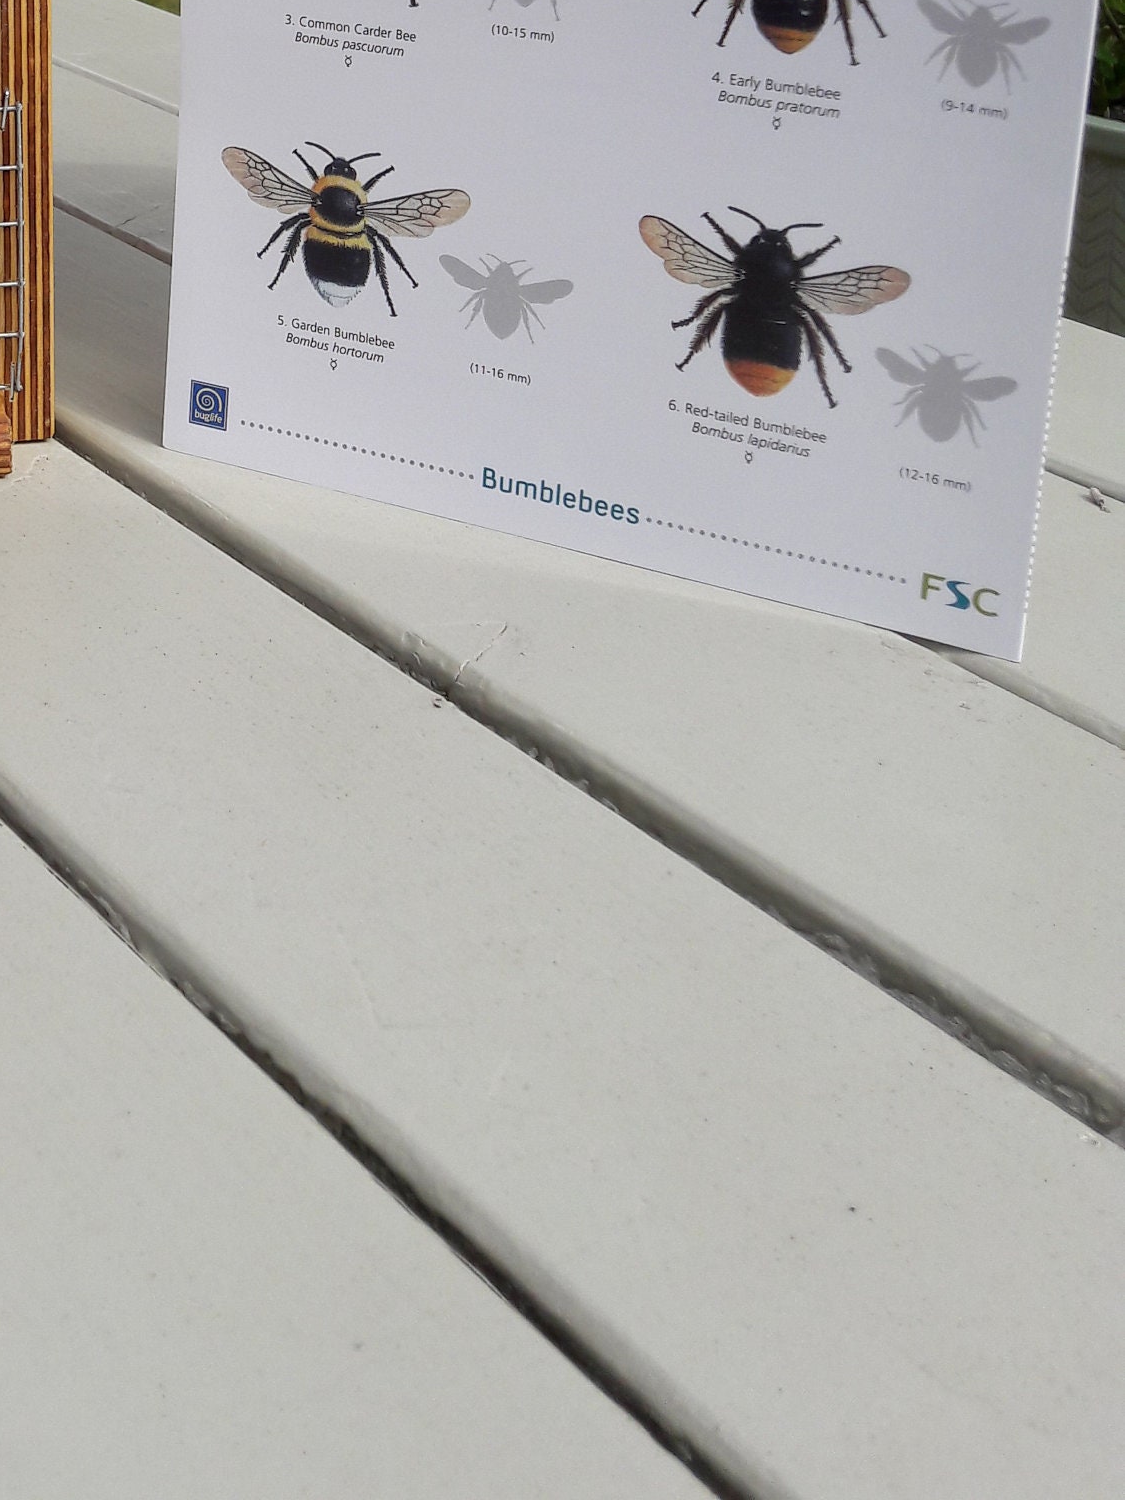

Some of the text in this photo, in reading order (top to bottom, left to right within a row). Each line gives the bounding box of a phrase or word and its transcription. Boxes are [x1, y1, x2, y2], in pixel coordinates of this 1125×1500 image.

[285, 14, 417, 43] 3. Common Carder Bee
[491, 24, 555, 44] (10-15 mm)
[294, 32, 405, 57] Bombus pascuorum
[711, 71, 841, 100] 4. Early Bumblebee
[718, 90, 841, 118] Bombus pratorum
[941, 99, 1008, 120] (9-14 mm)
[277, 315, 396, 350] 5. Garden Bumblebee
[286, 333, 384, 363] Bombus hortorum
[469, 362, 531, 386] (11-16 mm)
[668, 399, 827, 444] 6. Red-tailed Bumblebee
[692, 422, 812, 458] Bombus lapidarius
[899, 466, 972, 493] (12-16 mm)
[482, 466, 640, 525] Bumblebees
[921, 572, 1001, 618] FSC
